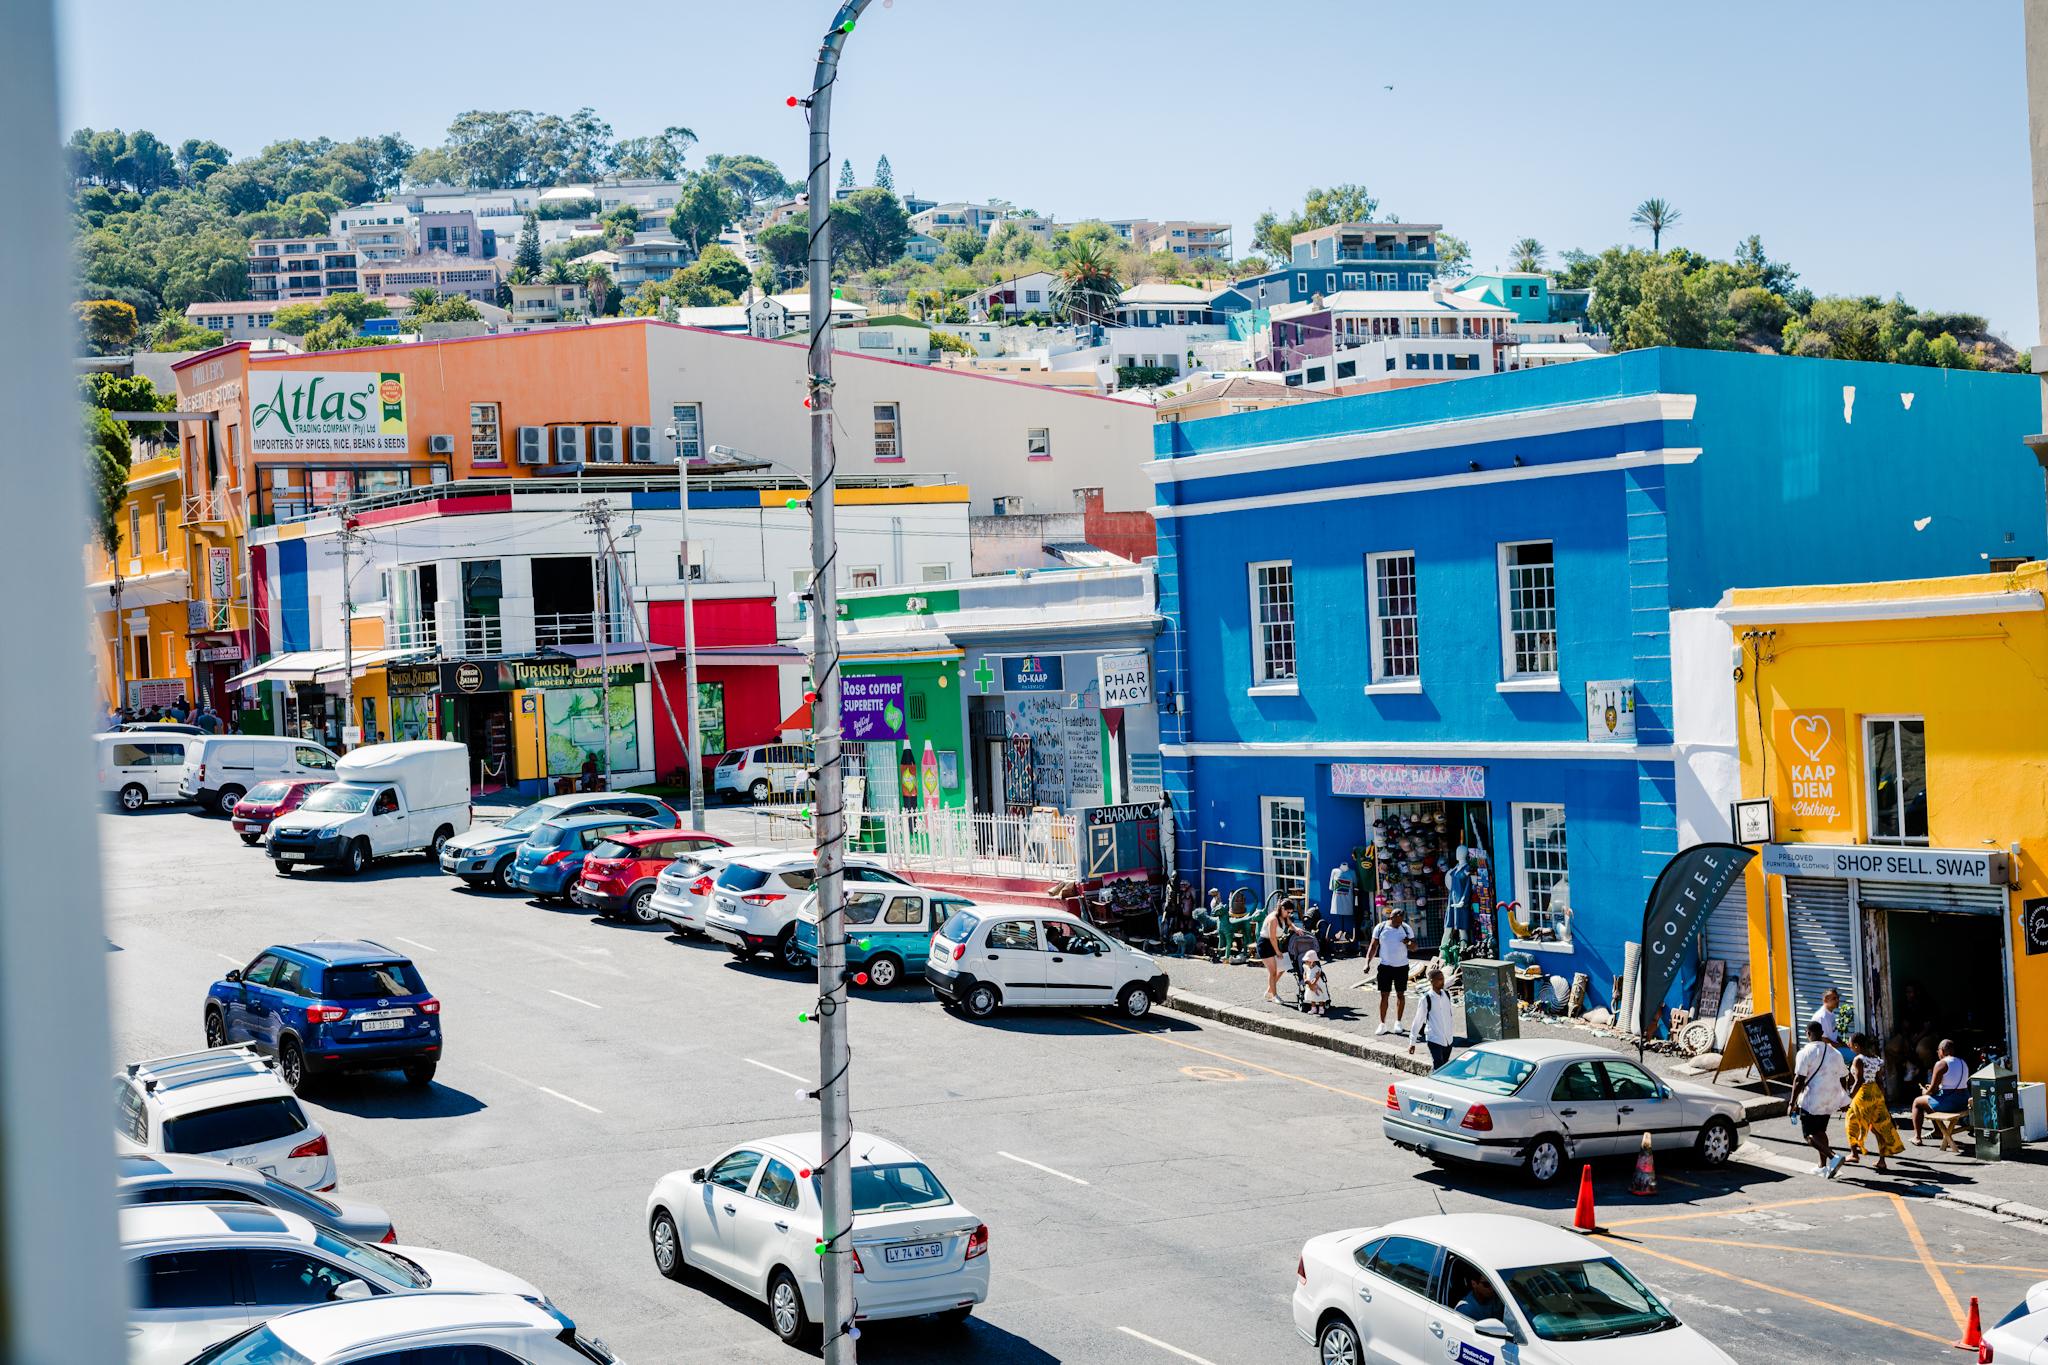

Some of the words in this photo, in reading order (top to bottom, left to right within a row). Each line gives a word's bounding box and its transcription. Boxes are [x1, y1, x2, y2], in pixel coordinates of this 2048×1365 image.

[252, 375, 368, 437] Atlas
[296, 424, 320, 433] TRADING
[323, 424, 350, 433] COMPANY
[352, 424, 365, 436] (Pty)
[366, 424, 376, 433] Ltd
[253, 439, 294, 450] IMPORTERS
[296, 439, 304, 449] OF
[305, 438, 331, 451] SPICES,
[333, 438, 350, 451] RICE,
[353, 438, 376, 449] BEANS
[377, 438, 382, 448] &
[384, 438, 406, 449] SEEDS
[512, 662, 570, 681] TURKISH
[1017, 673, 1048, 683] BO-KAAP
[1104, 671, 1145, 687] PHAR
[534, 678, 565, 687] GROCER
[566, 678, 573, 686] &
[843, 681, 866, 695] Rose
[868, 682, 902, 695] corner
[1106, 685, 1148, 701] MACY
[844, 698, 884, 712] SUPERETTE
[1360, 768, 1408, 783] BO-KAAP
[1411, 769, 1451, 784] BAZAAR
[1791, 765, 1836, 781] KAAP
[1792, 782, 1832, 798] DIEM
[1096, 804, 1155, 823] PHARMACY
[1792, 801, 1840, 823] Clothing
[1766, 861, 1795, 869] FURNITURE
[1801, 862, 1830, 870] CLOTHING
[1778, 853, 1814, 862] PRELOVED
[1837, 854, 1881, 872] SHOP.
[1886, 856, 1932, 875] SELL.
[1936, 858, 1986, 877] SWAP.
[1712, 859, 1738, 893] COFFEE
[1652, 855, 1718, 955] COFFEE
[889, 1249, 898, 1260] LY
[902, 1248, 912, 1257] 74
[915, 1246, 925, 1257] WS
[930, 1244, 940, 1255] GP
